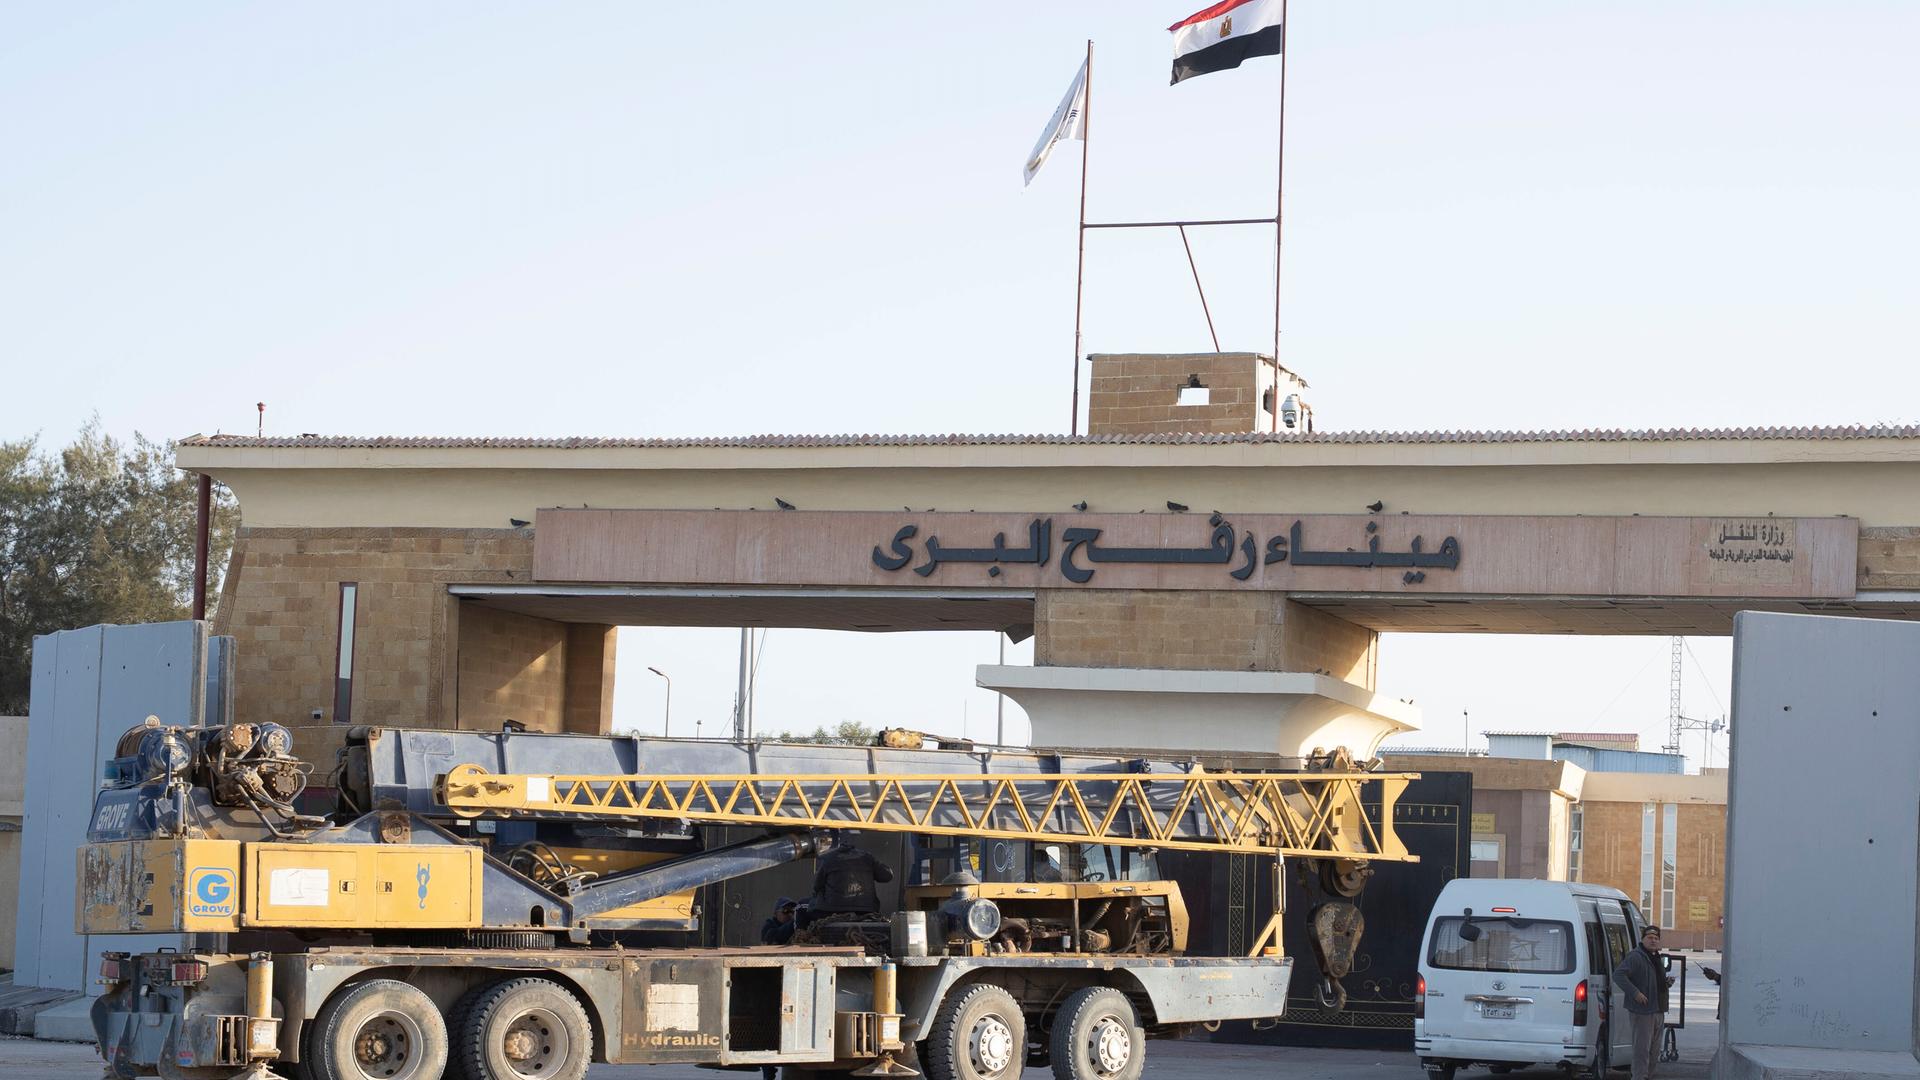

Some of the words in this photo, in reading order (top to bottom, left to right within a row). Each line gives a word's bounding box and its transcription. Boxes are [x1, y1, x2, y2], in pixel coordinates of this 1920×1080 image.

[1719, 524, 1758, 545] النقل
[1762, 525, 1785, 546] وزارة
[1060, 513, 1257, 583] رفح
[1264, 519, 1462, 585] ميناء
[96, 802, 130, 830] GROVE
[193, 905, 231, 913] GROVE
[623, 1033, 721, 1049] Hydraulic
